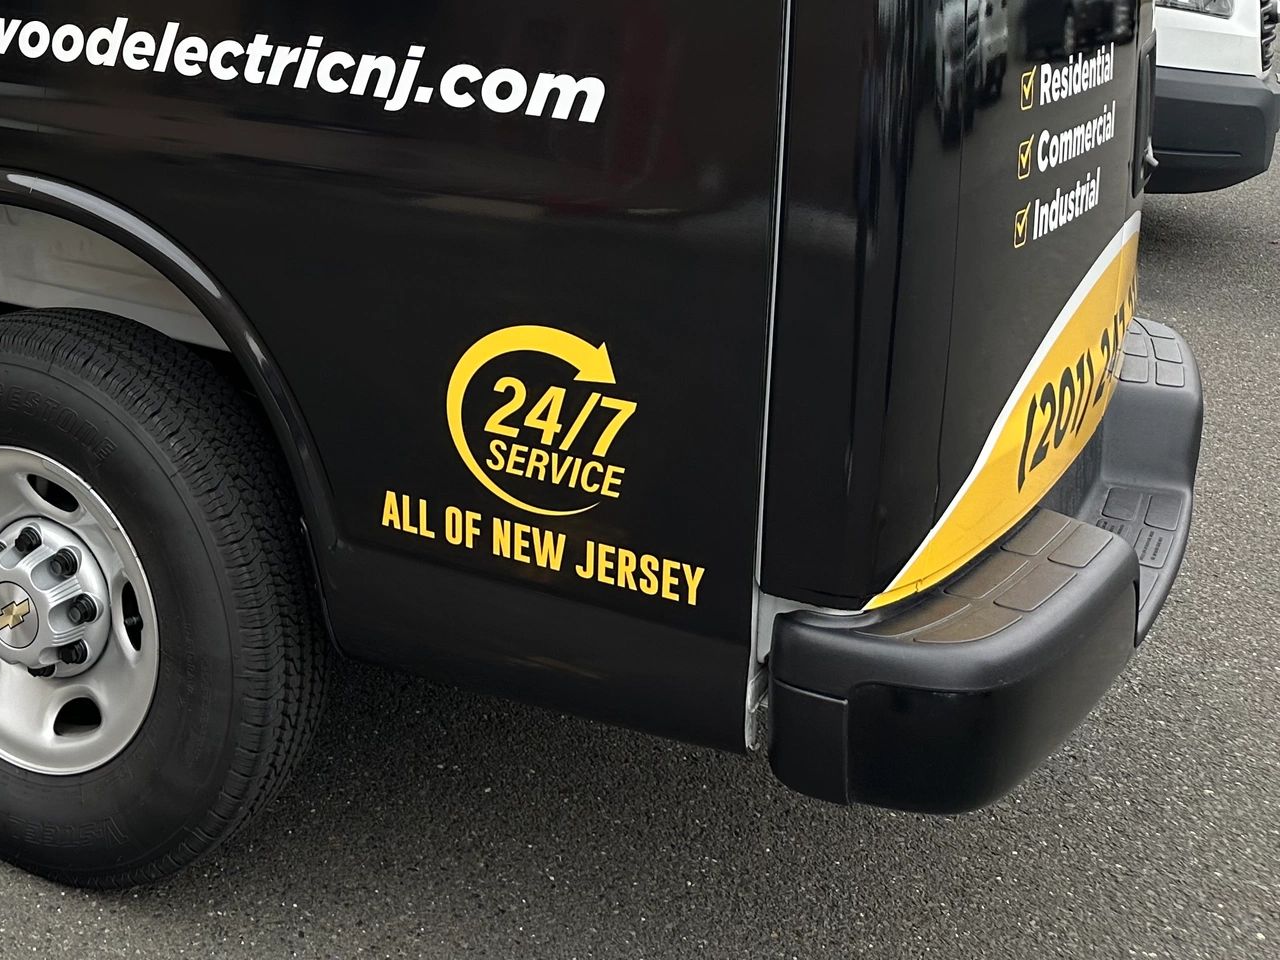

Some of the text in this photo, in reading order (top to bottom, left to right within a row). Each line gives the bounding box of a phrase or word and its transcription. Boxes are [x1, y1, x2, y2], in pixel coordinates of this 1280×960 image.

[1039, 43, 1114, 105] Residential
[1036, 102, 1115, 172] Commercial
[1032, 167, 1101, 240] Industrial
[483, 376, 638, 458] 24/7
[1017, 348, 1095, 494] (201)
[485, 439, 626, 499] SERVICE
[381, 490, 705, 606] ALL OF NEW JERSEY
